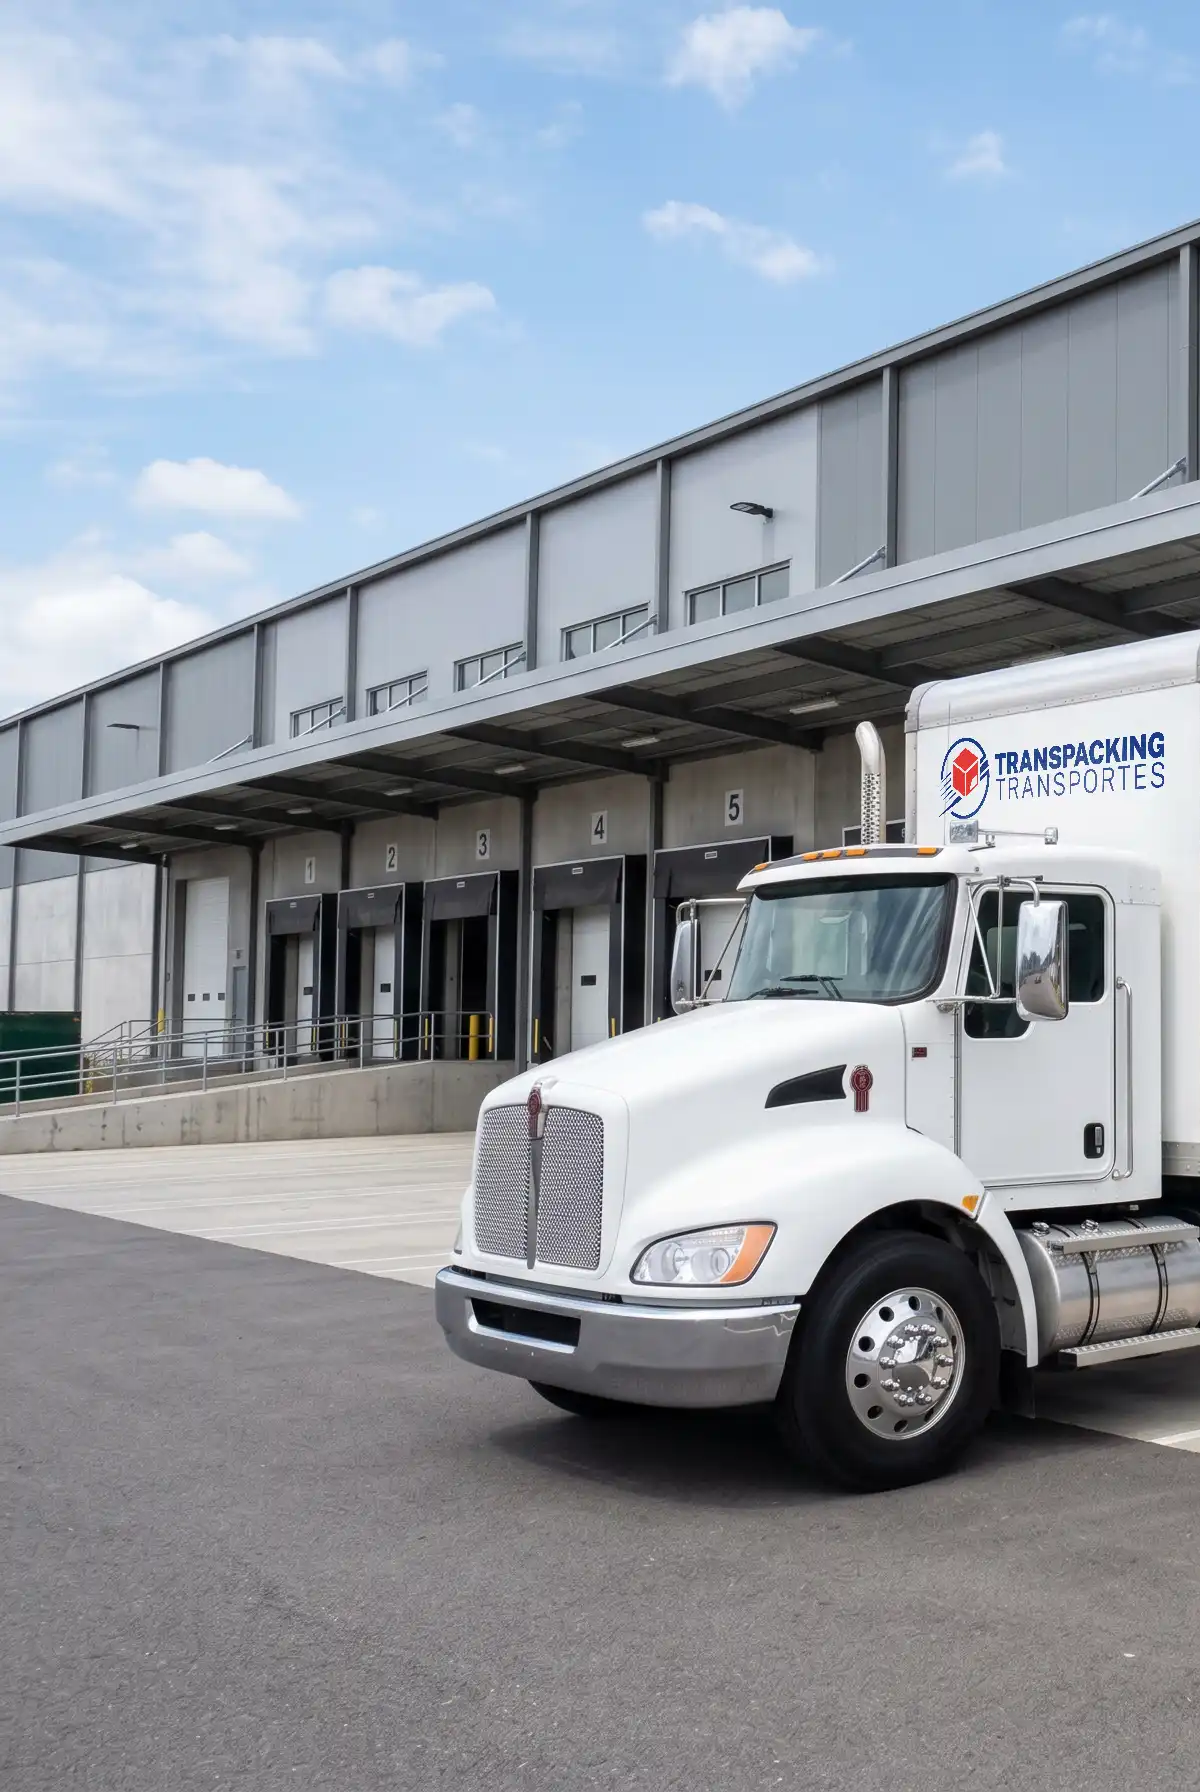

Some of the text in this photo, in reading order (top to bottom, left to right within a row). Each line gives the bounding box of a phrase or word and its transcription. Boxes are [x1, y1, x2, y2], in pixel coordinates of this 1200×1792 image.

[995, 732, 1164, 776] TRANSPACKING
[996, 762, 1164, 800] TRANSPORTES
[728, 793, 740, 821] 5
[594, 815, 605, 839] 4
[388, 846, 396, 868] 2
[478, 833, 487, 856] 3
